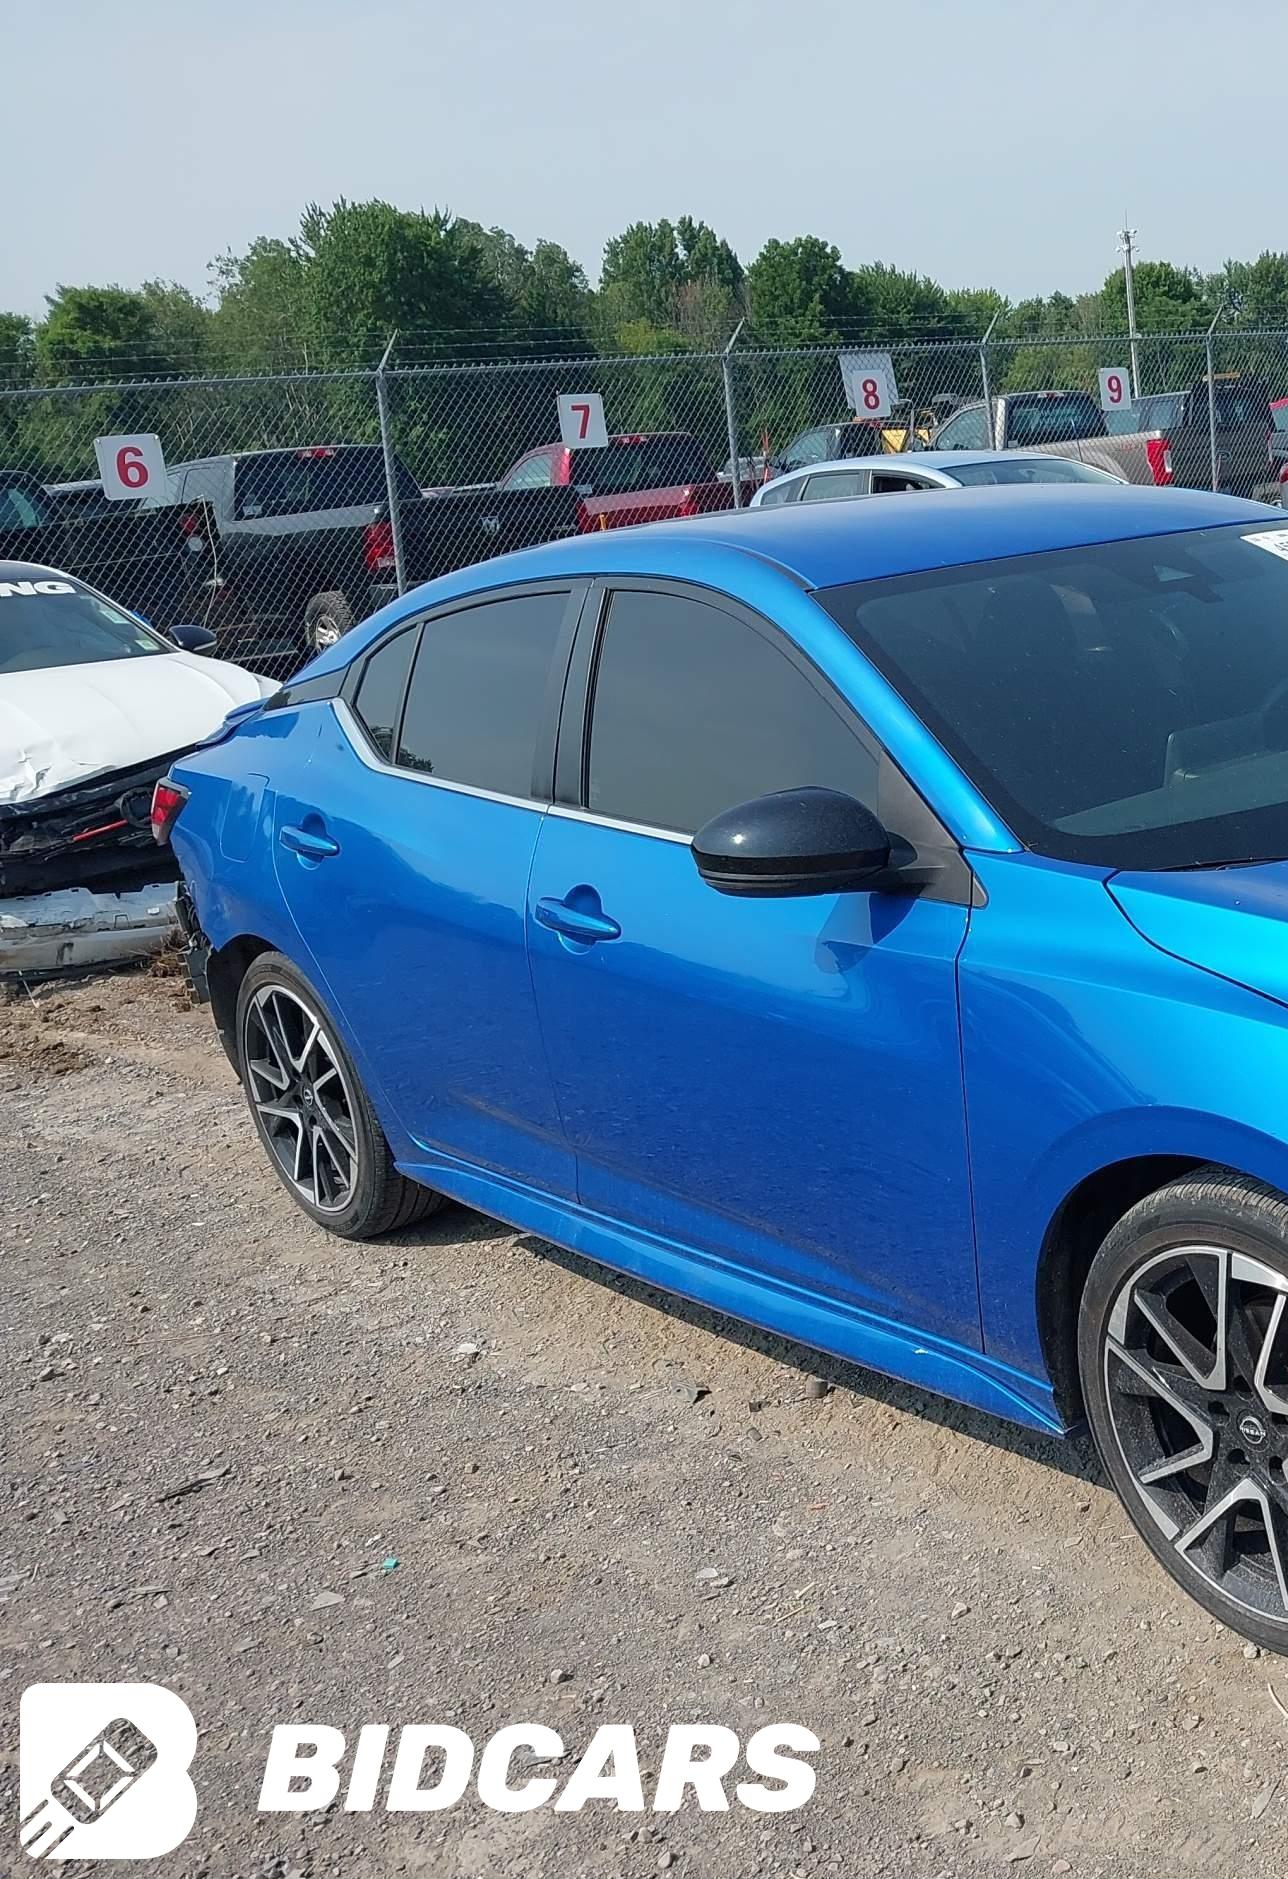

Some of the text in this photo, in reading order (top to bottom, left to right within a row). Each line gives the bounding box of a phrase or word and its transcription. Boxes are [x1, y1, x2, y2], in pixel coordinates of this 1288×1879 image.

[862, 378, 880, 410] 8
[1107, 375, 1123, 404] 9
[570, 404, 591, 440] 7
[116, 446, 149, 489] 6
